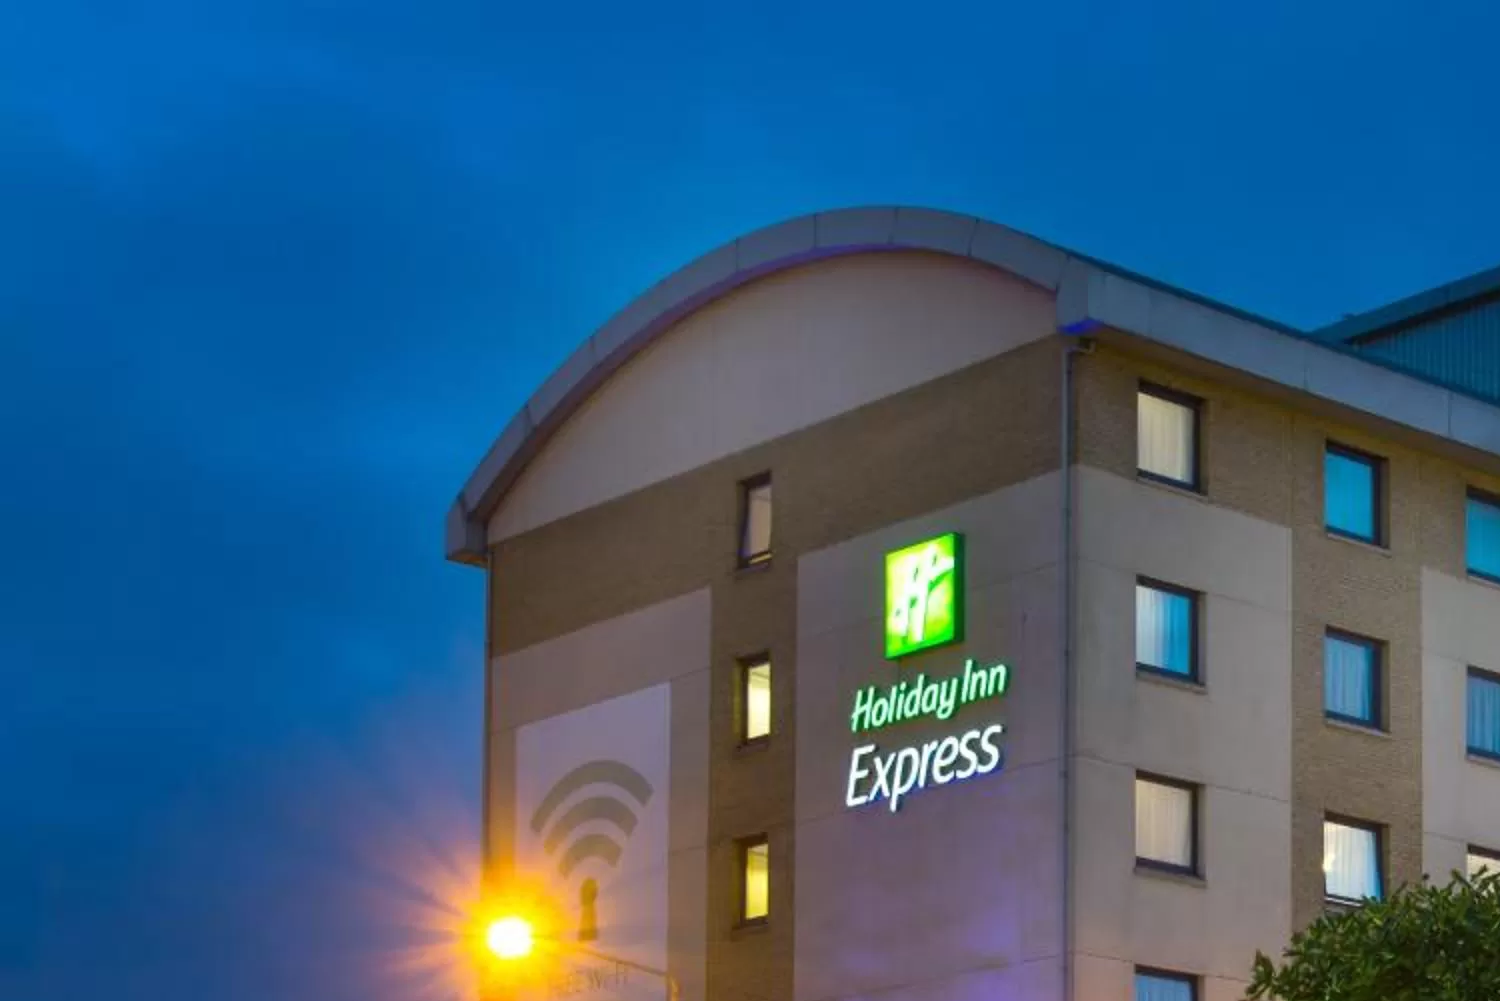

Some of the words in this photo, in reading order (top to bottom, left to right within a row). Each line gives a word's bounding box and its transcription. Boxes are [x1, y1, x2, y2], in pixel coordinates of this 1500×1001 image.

[851, 673, 957, 732] Holiday
[960, 658, 1007, 702] Inn
[846, 725, 1003, 812] Express
